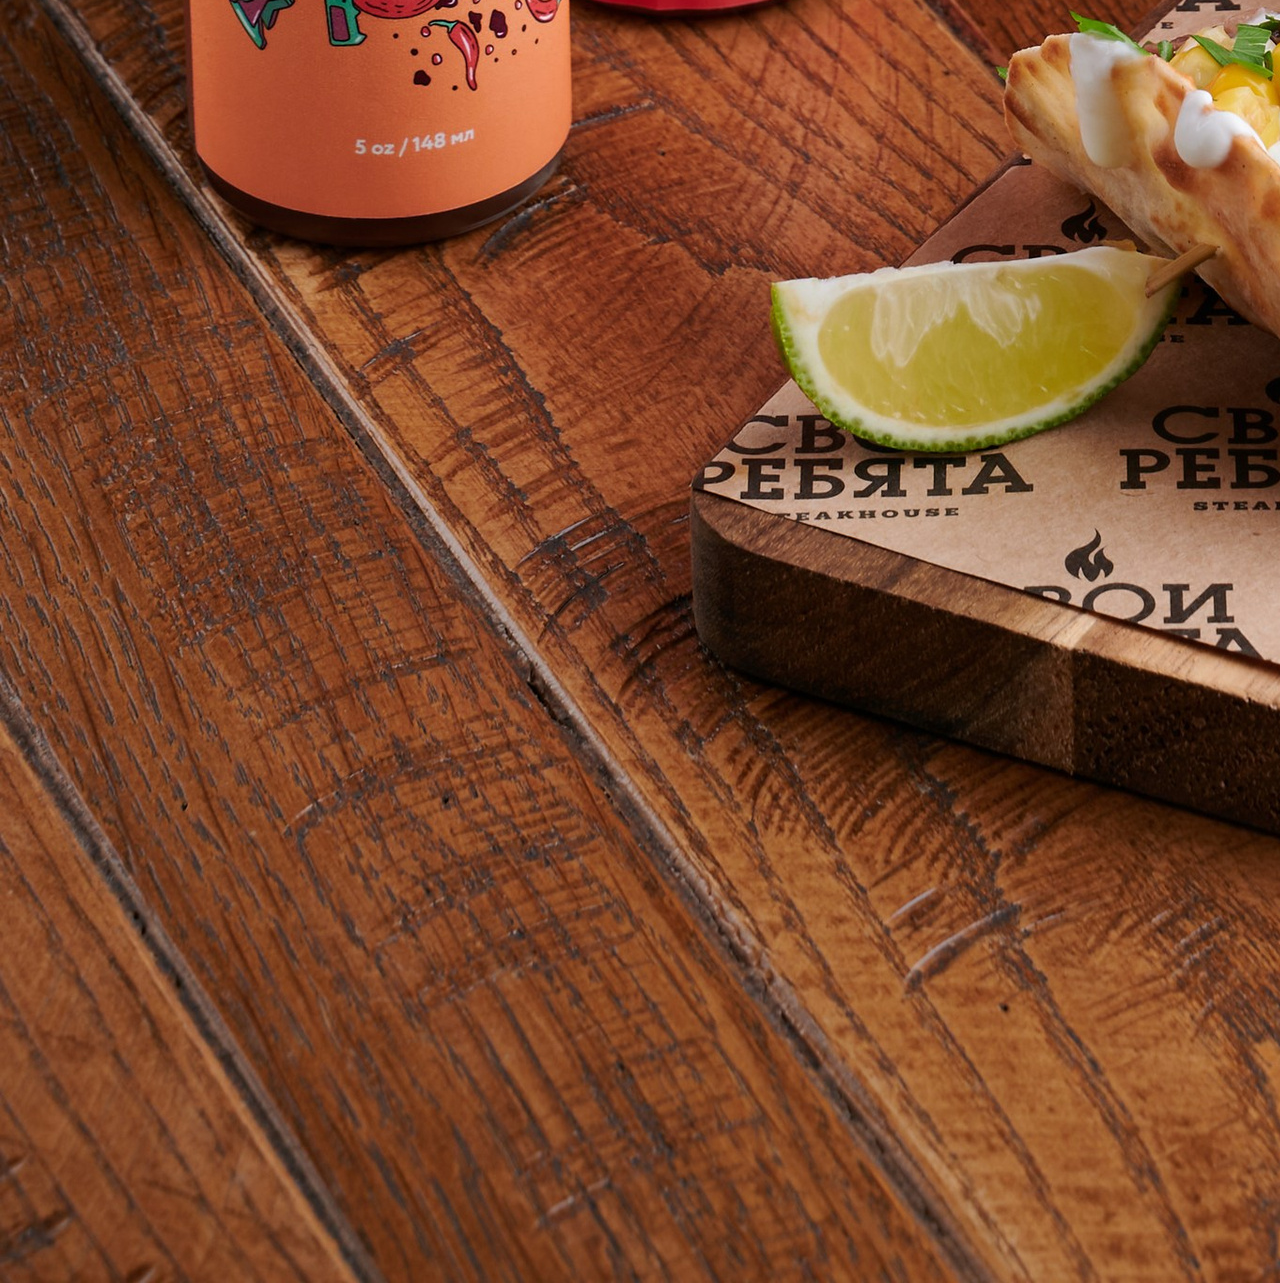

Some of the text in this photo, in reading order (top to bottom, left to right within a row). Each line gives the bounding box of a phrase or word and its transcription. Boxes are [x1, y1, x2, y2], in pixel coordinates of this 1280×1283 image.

[355, 139, 367, 154] 5
[371, 143, 395, 155] oz
[412, 132, 446, 152] 148
[450, 129, 475, 145] мл
